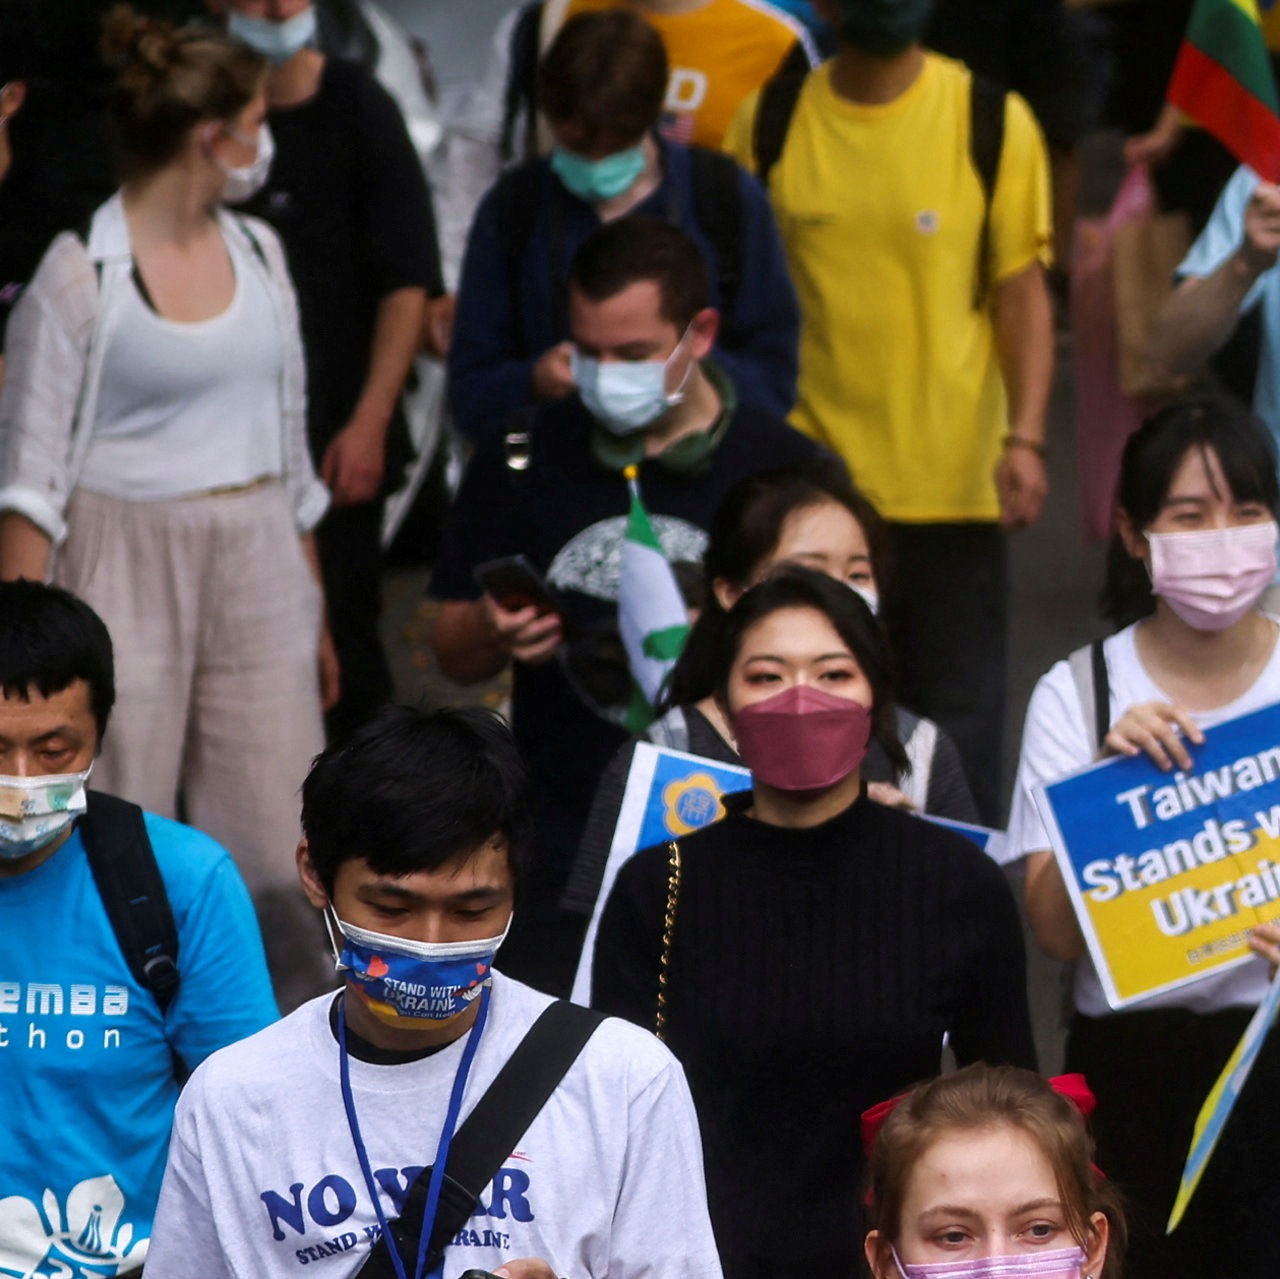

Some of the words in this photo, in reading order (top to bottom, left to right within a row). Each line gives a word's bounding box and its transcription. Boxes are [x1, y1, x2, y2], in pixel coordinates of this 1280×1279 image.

[1083, 817, 1258, 903] Stands
[383, 976, 427, 997] STAND
[260, 1174, 357, 1241] NO
[296, 1231, 358, 1265] STAND
